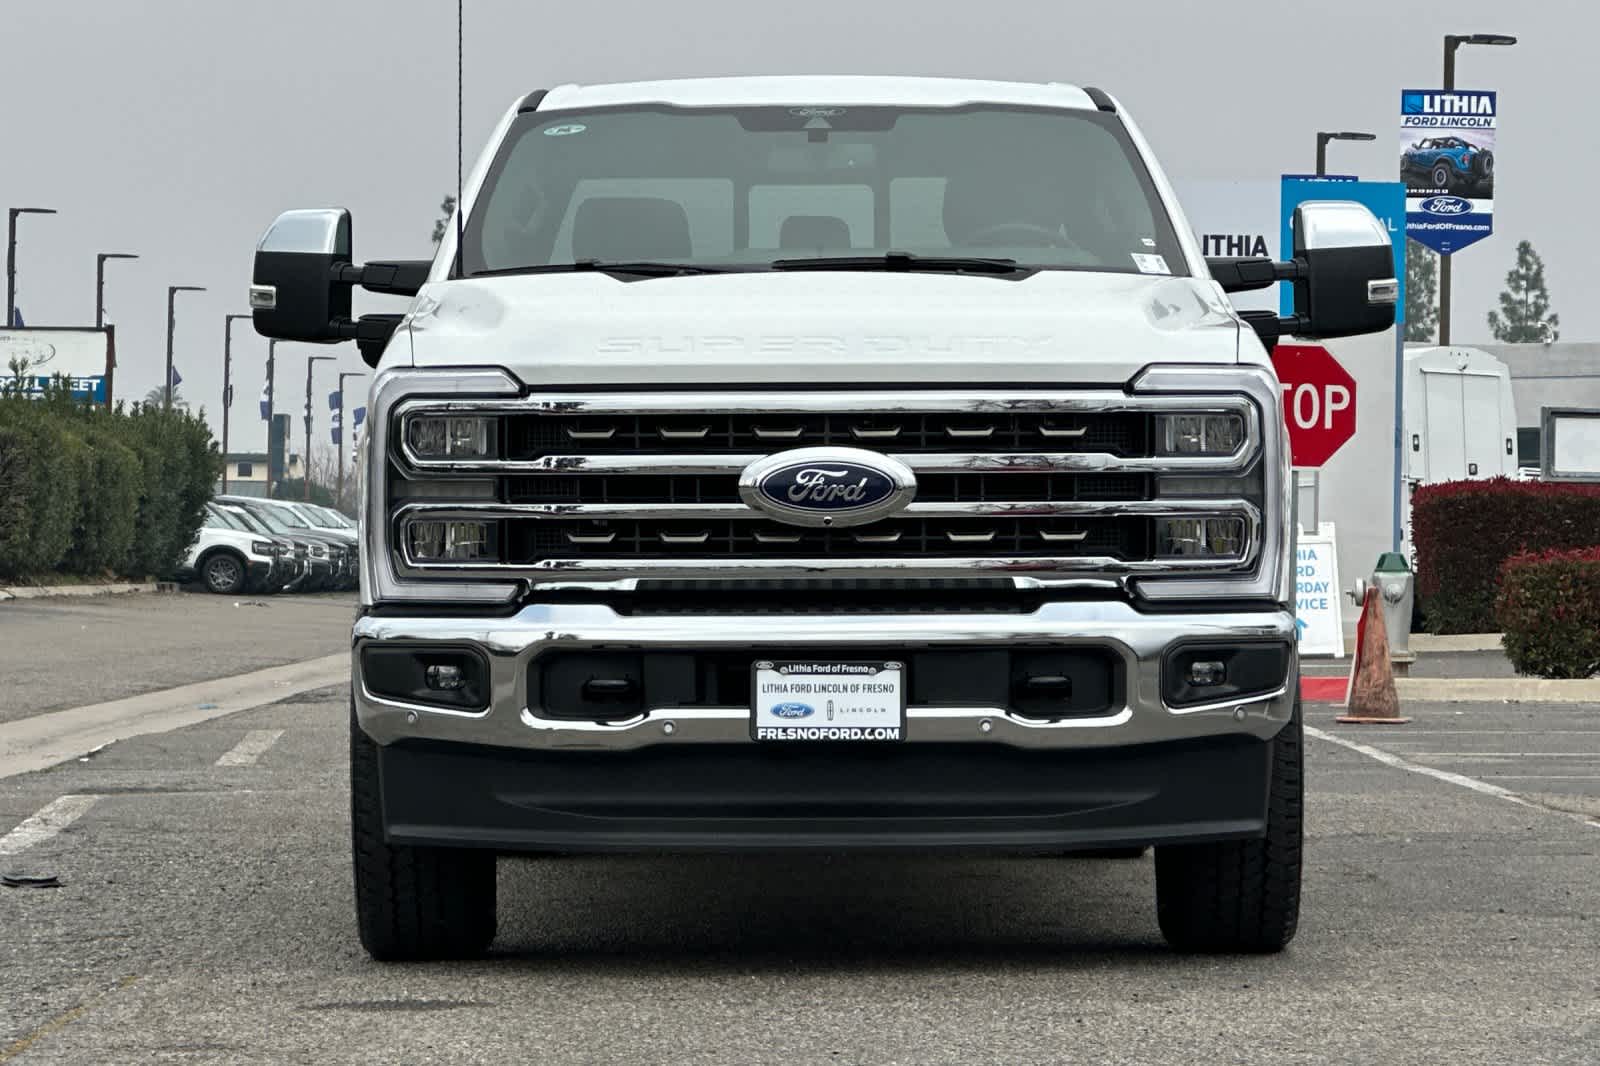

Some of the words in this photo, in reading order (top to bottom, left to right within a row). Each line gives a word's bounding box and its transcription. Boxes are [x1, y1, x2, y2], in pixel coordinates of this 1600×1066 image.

[1423, 95, 1493, 114] LITHIA
[1404, 116, 1439, 127] FORD
[1440, 116, 1492, 127] LINCOLN
[1430, 198, 1463, 213] Ford
[1406, 221, 1490, 231] ithiaFordOfFresno.com
[1203, 234, 1269, 256] ITHIA
[597, 335, 849, 353] SUPER
[862, 335, 1055, 353] DUTY
[1280, 382, 1351, 430] TOP
[787, 468, 868, 501] Ford
[1296, 565, 1316, 577] RD
[1296, 581, 1329, 593] RDAY
[1296, 598, 1329, 610] VICE
[788, 664, 812, 673] Lithia
[813, 664, 831, 673] Ford
[832, 664, 842, 673] of
[841, 664, 869, 673] Fresno
[762, 683, 789, 694] LITHIA
[790, 683, 812, 694] FORD
[813, 683, 848, 694] LINCOLN
[850, 683, 861, 694] OF
[862, 683, 895, 694] FRESNO
[757, 728, 900, 740] FRESNOFORD.COM
